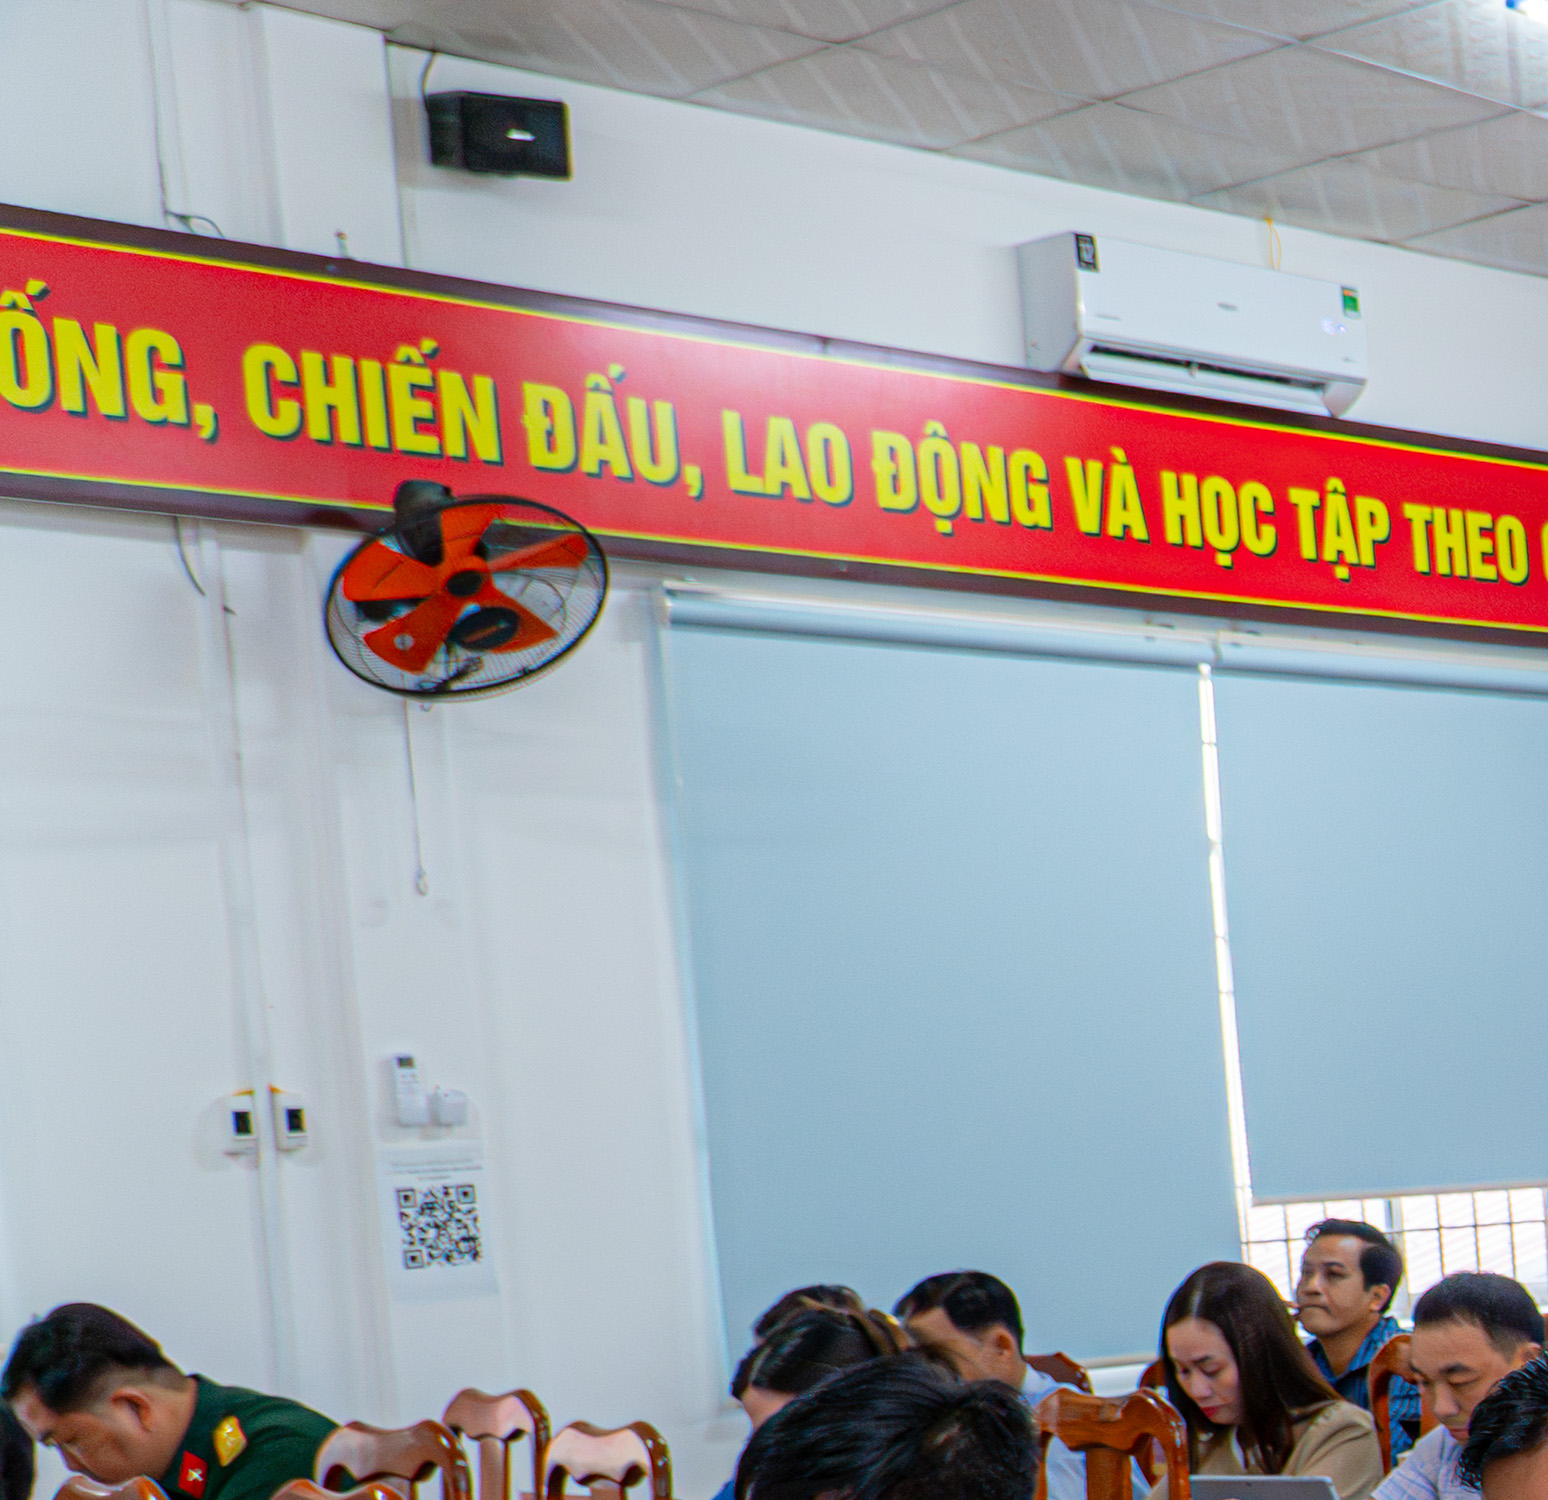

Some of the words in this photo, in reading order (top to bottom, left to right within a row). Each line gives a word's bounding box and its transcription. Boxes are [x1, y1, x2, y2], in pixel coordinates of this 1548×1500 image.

[0, 278, 214, 439] ỐNG,
[241, 337, 499, 461] CHIẾN
[520, 364, 701, 497] ĐẤU,
[721, 410, 851, 503] LAO
[870, 420, 1052, 534] ĐỘNG
[1064, 446, 1150, 541] VÀ
[1159, 469, 1277, 567] HỌC
[1287, 476, 1391, 580] TẬP
[1402, 501, 1529, 584] THEO
